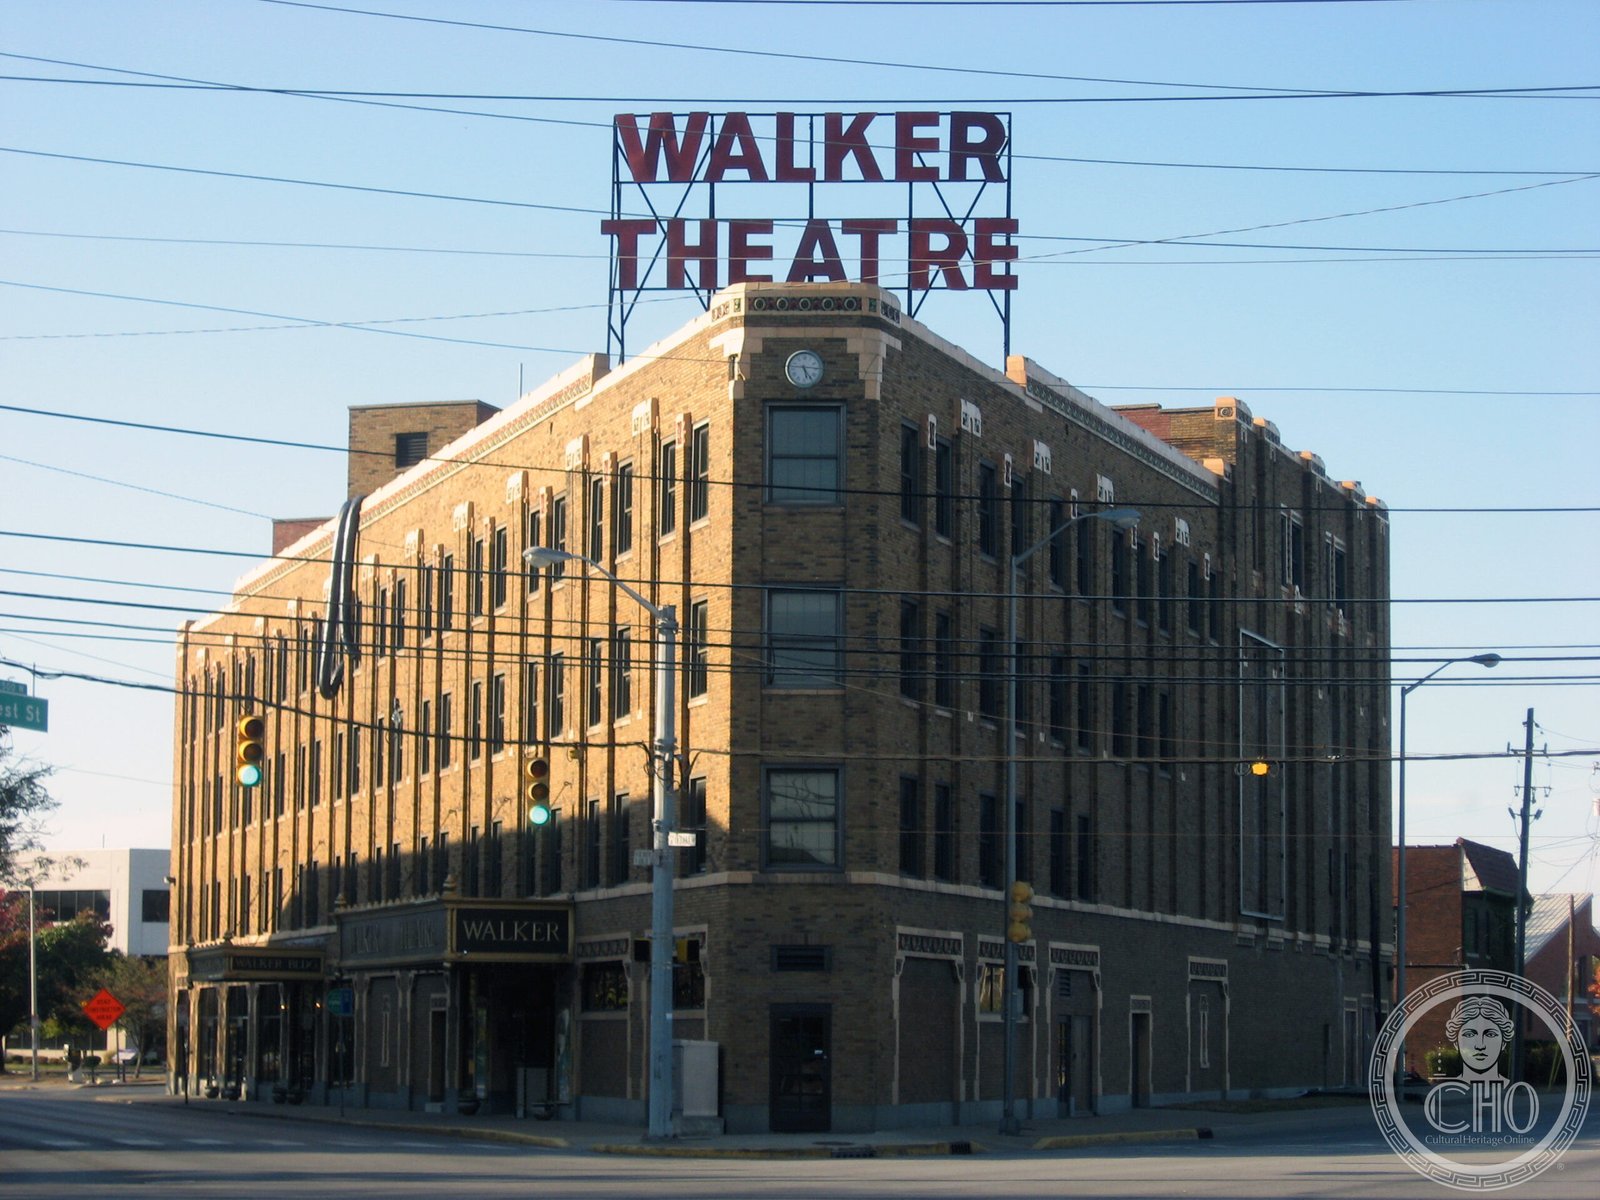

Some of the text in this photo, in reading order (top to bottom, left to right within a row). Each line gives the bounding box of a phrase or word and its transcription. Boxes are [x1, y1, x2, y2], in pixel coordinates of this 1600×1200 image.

[614, 111, 1006, 183] WALKER
[601, 218, 1019, 291] THEATRE
[26, 704, 41, 723] St
[463, 920, 561, 942] WALKER
[235, 958, 282, 970] WALKER
